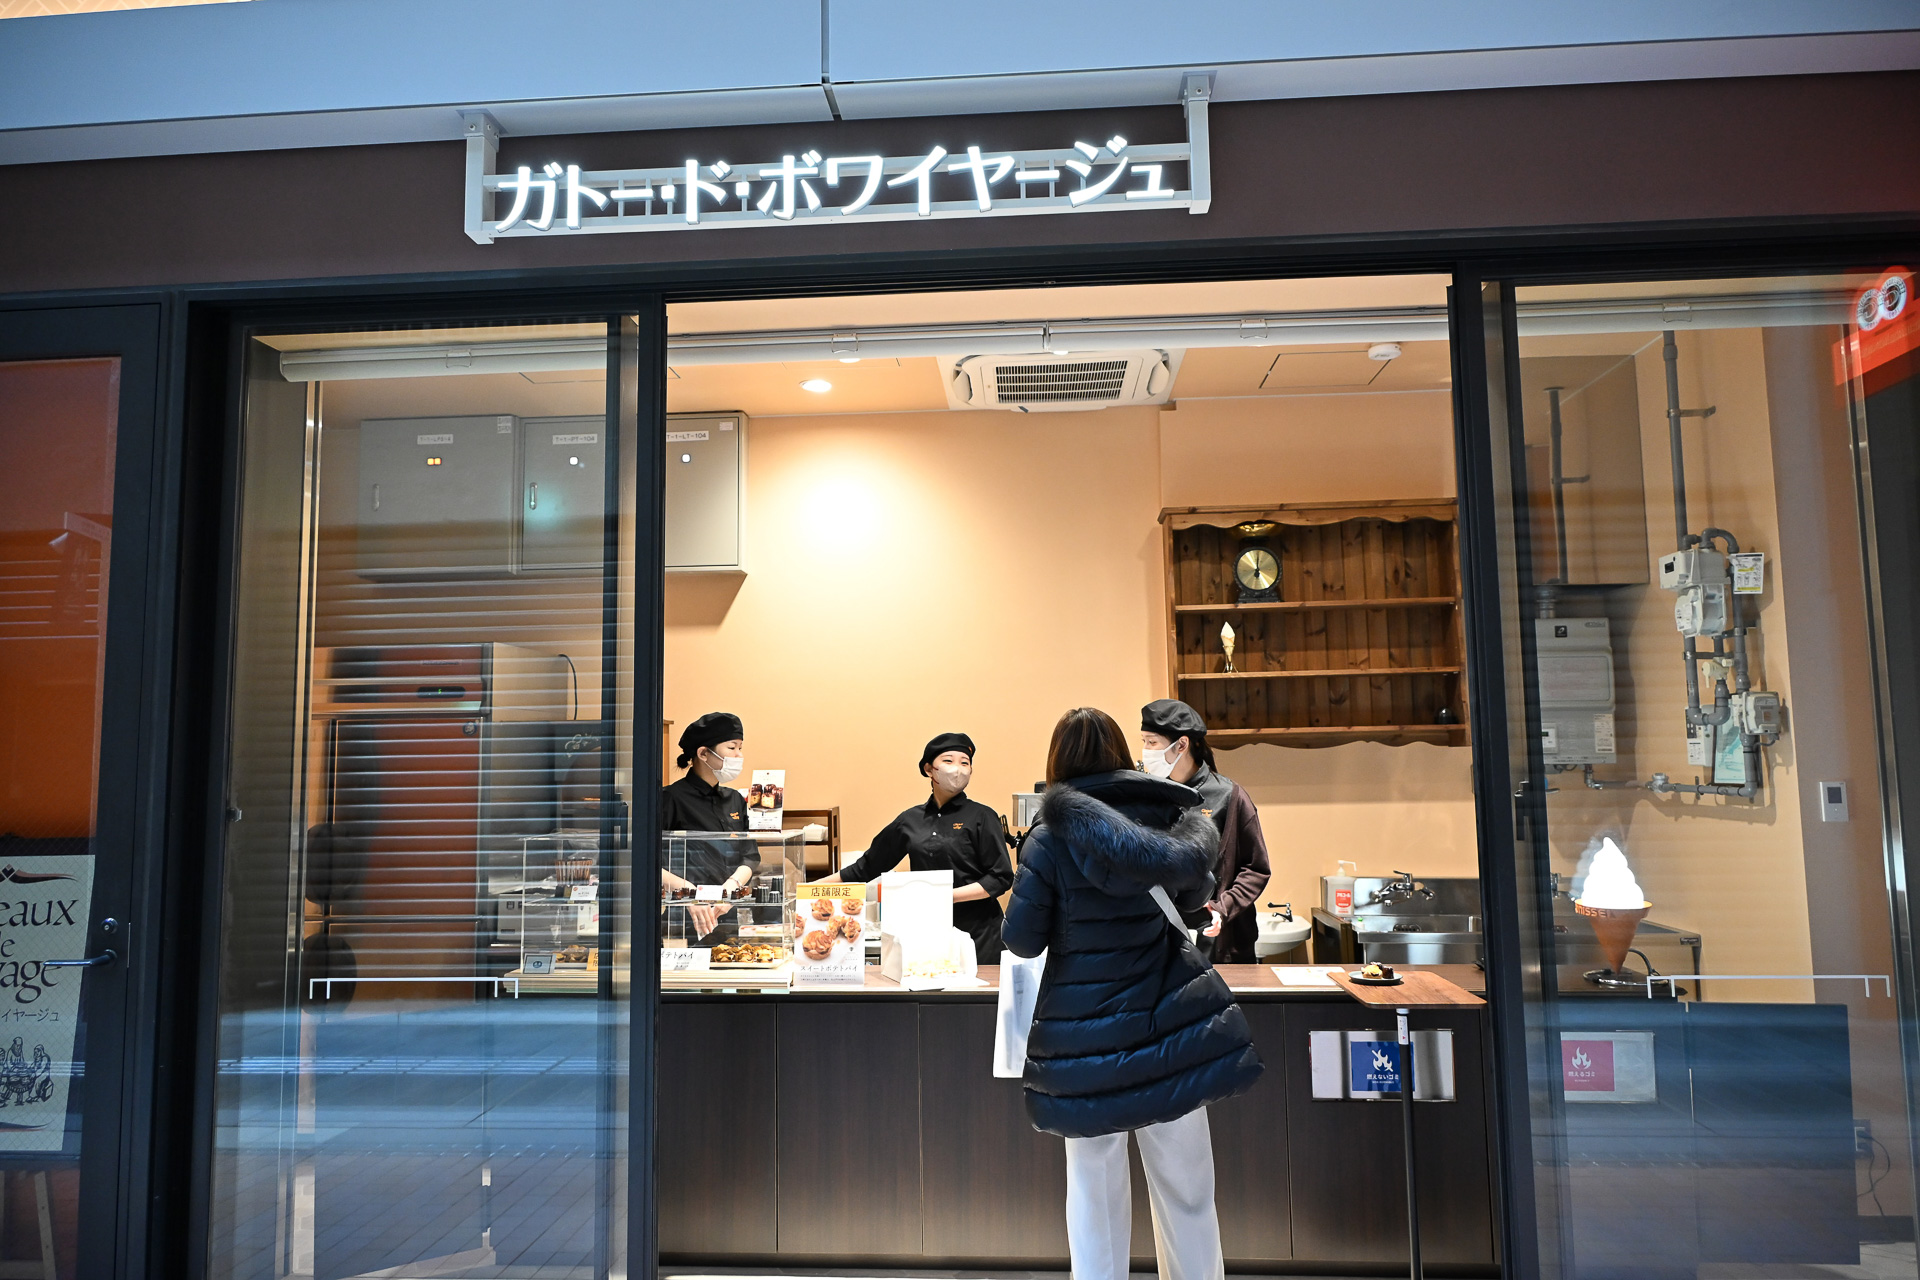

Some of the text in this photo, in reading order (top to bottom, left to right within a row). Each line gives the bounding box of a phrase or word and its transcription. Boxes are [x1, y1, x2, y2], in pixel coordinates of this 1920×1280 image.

[495, 135, 1175, 233] ガトー・ド・ボワイヤージュ
[810, 886, 852, 898] 店舗限定
[0, 930, 16, 958] e
[1, 1008, 60, 1023] イヤージュ
